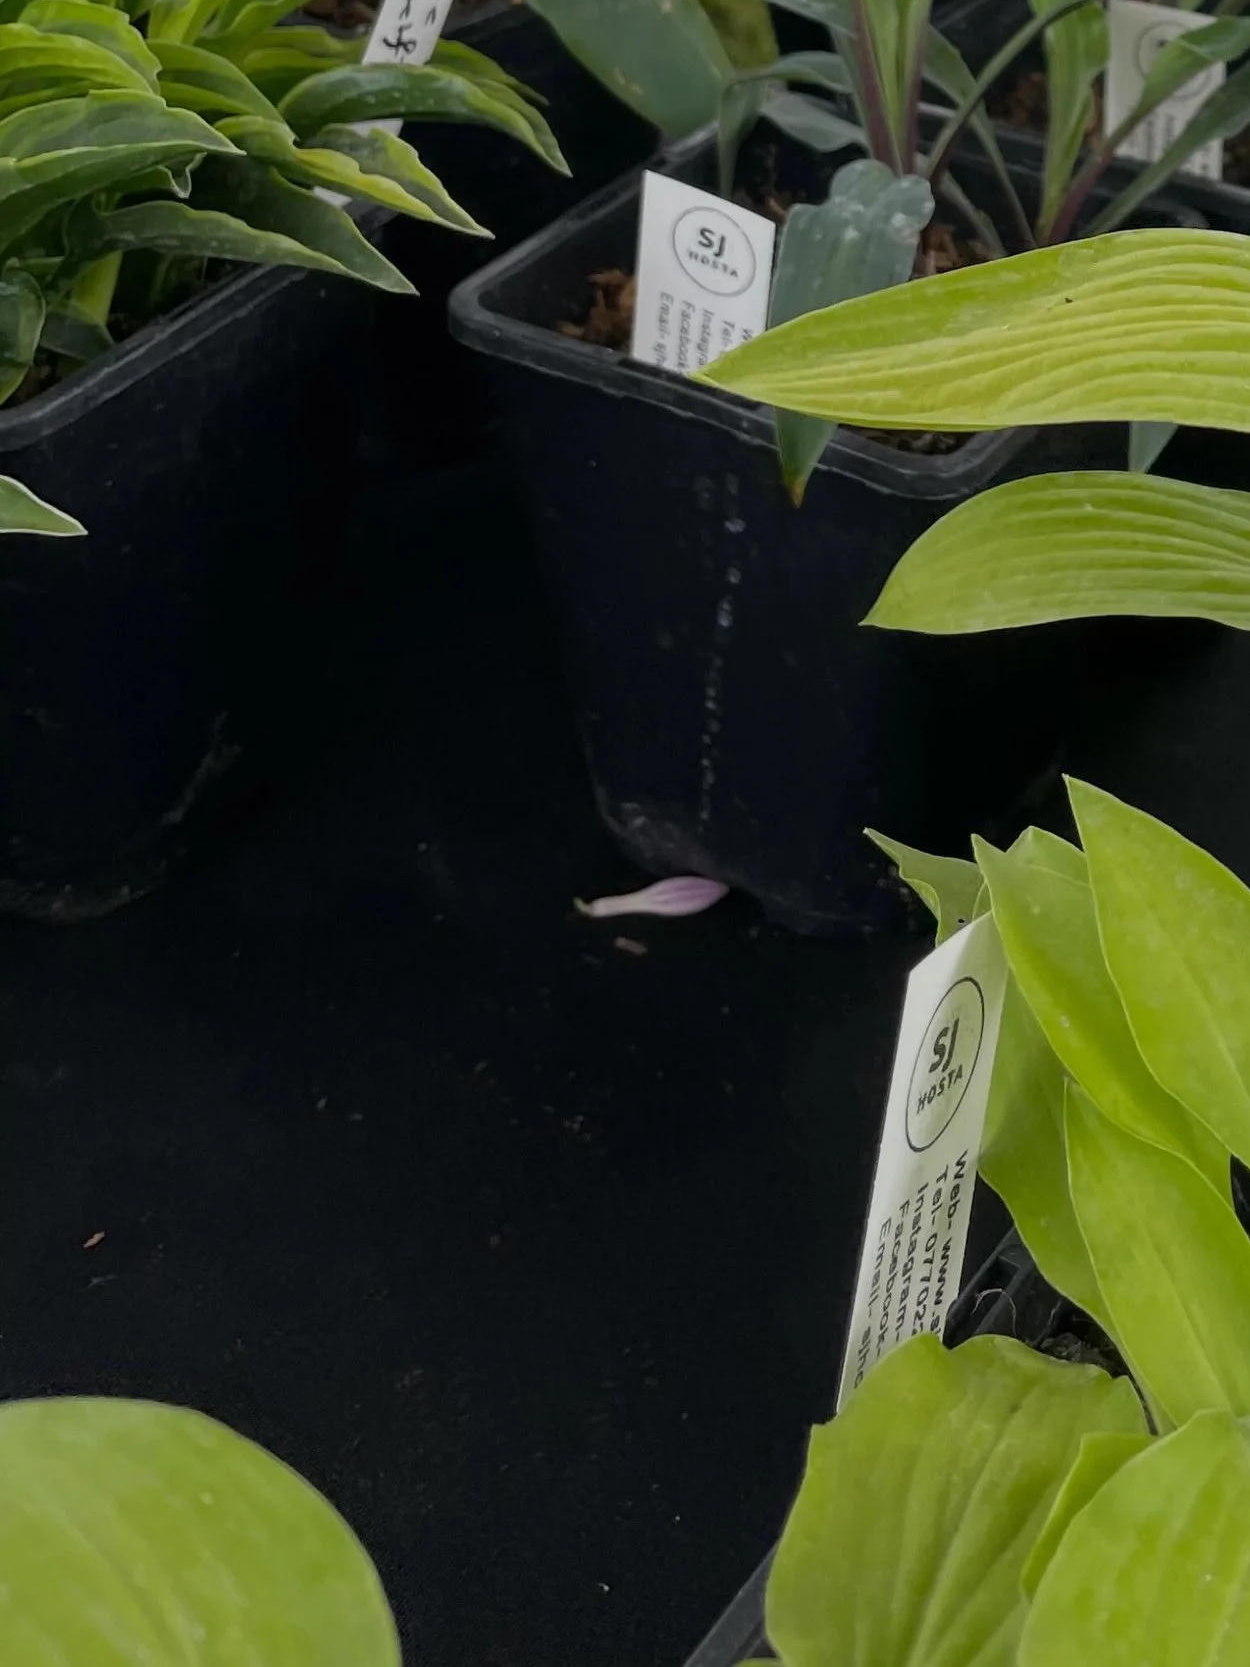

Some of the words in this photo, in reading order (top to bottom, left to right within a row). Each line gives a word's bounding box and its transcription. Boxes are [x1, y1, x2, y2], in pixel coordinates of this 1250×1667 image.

[688, 249, 739, 278] HOSTA
[698, 226, 727, 258] SJ
[696, 308, 715, 366] Instagra
[927, 1017, 960, 1074] SJ
[916, 1063, 964, 1115] HOSTA
[930, 1163, 949, 1227] Tel-
[946, 1148, 969, 1231] Web-
[867, 1217, 892, 1319] Email-
[876, 1199, 910, 1359] Facebook-
[894, 1182, 929, 1343] Instagram-
